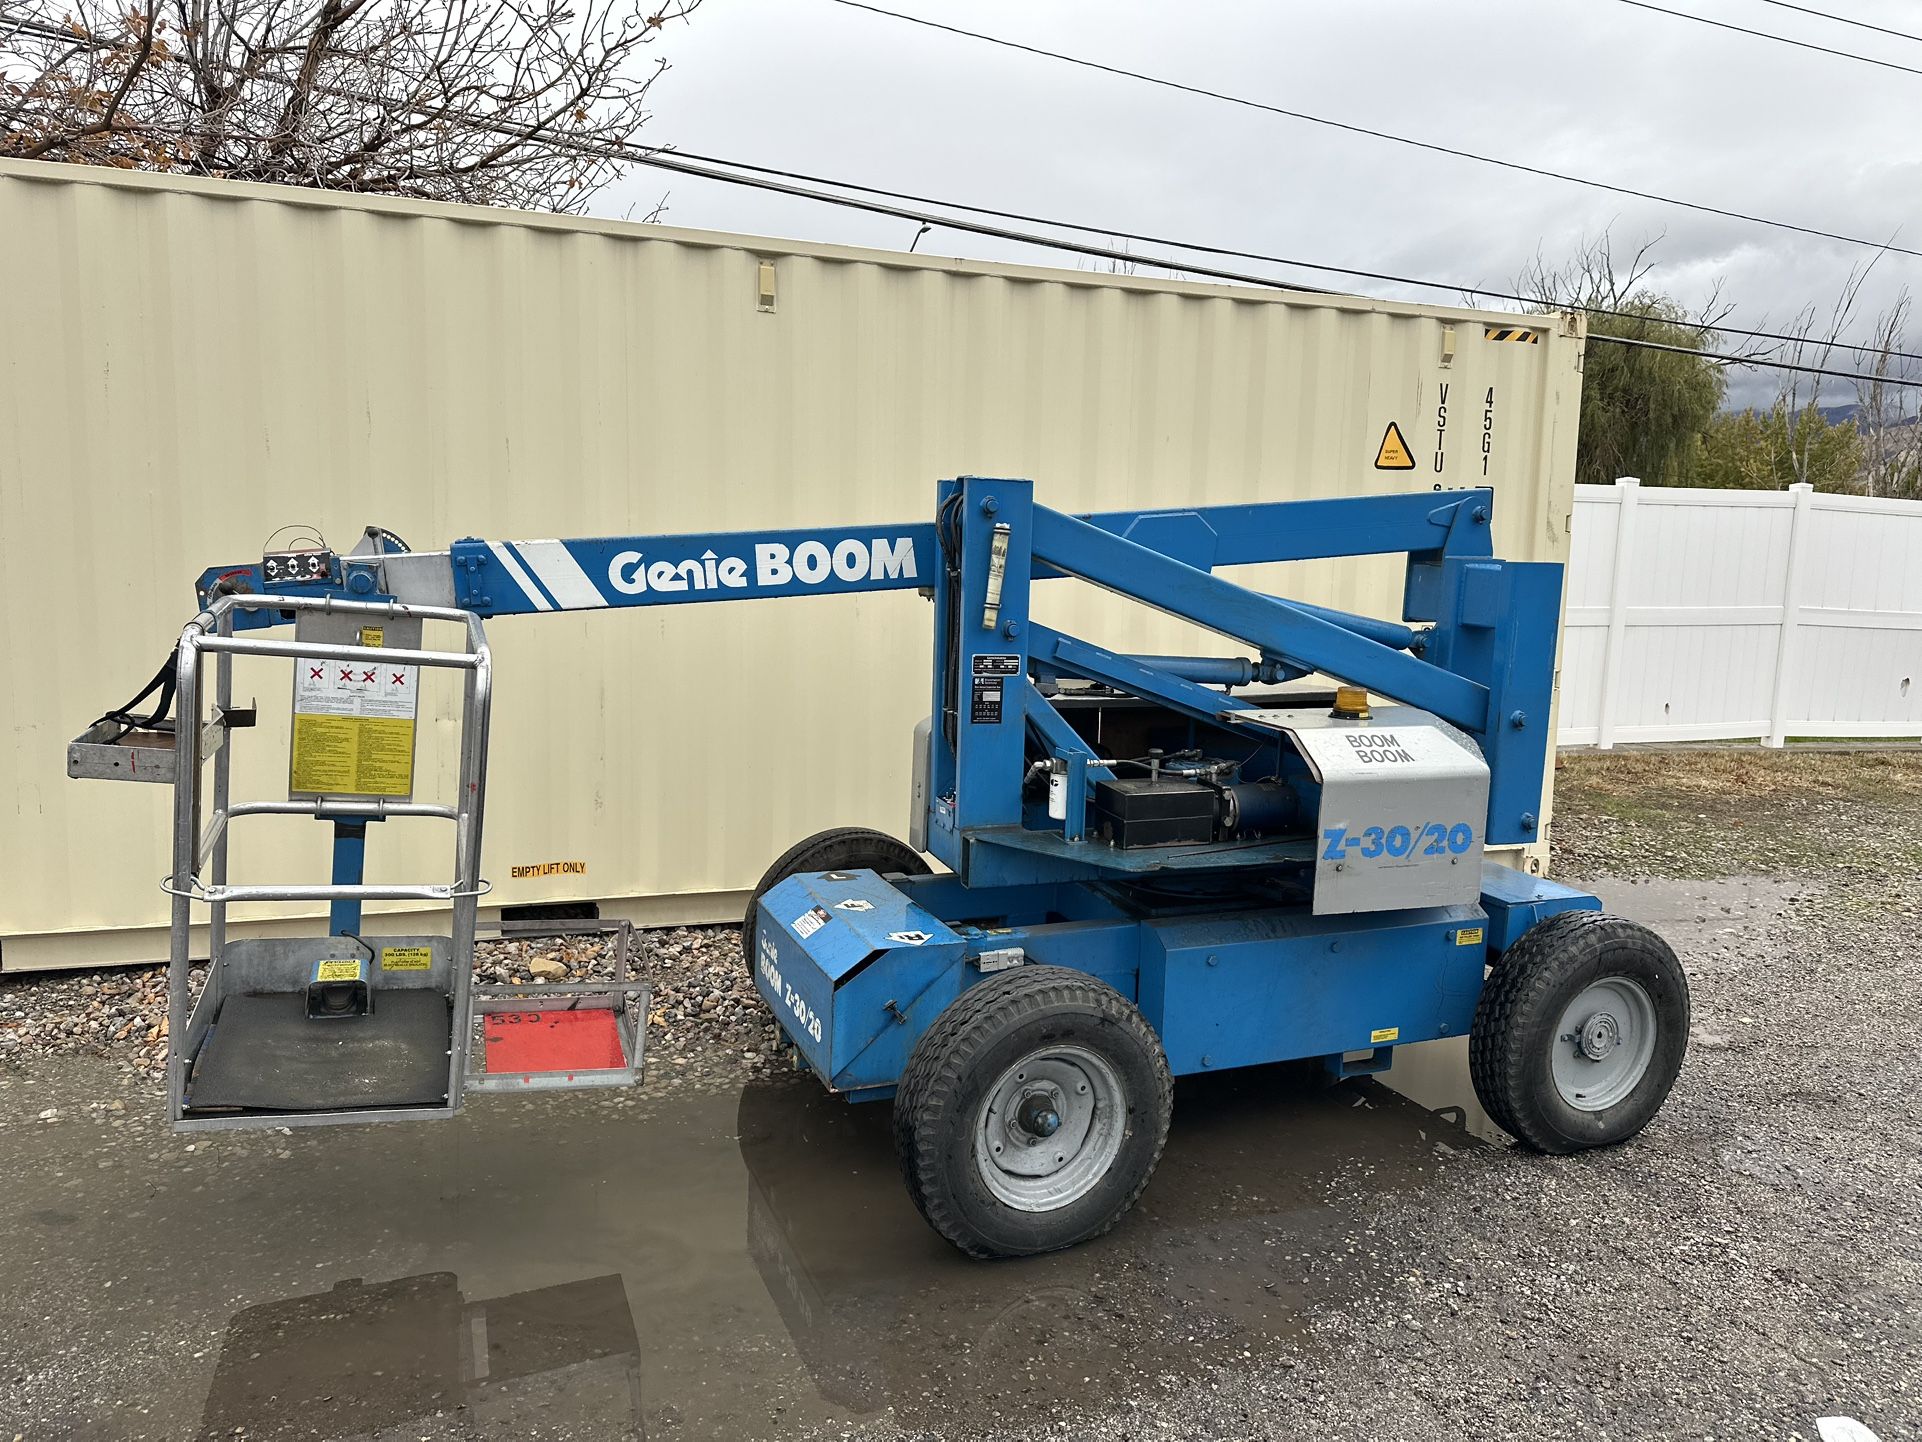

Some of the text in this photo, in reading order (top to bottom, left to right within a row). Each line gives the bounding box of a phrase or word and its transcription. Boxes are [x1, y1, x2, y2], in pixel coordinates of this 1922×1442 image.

[1434, 382, 1449, 473] VSTU
[1482, 386, 1494, 476] 45G1
[755, 537, 918, 586] BOOM
[1345, 734, 1401, 748] BOOM
[1355, 749, 1416, 764] BOOM
[1322, 821, 1473, 861] Z-30/20
[511, 862, 586, 878] EMPTY LIFT ONLY
[785, 981, 822, 1044] Z-30/20
